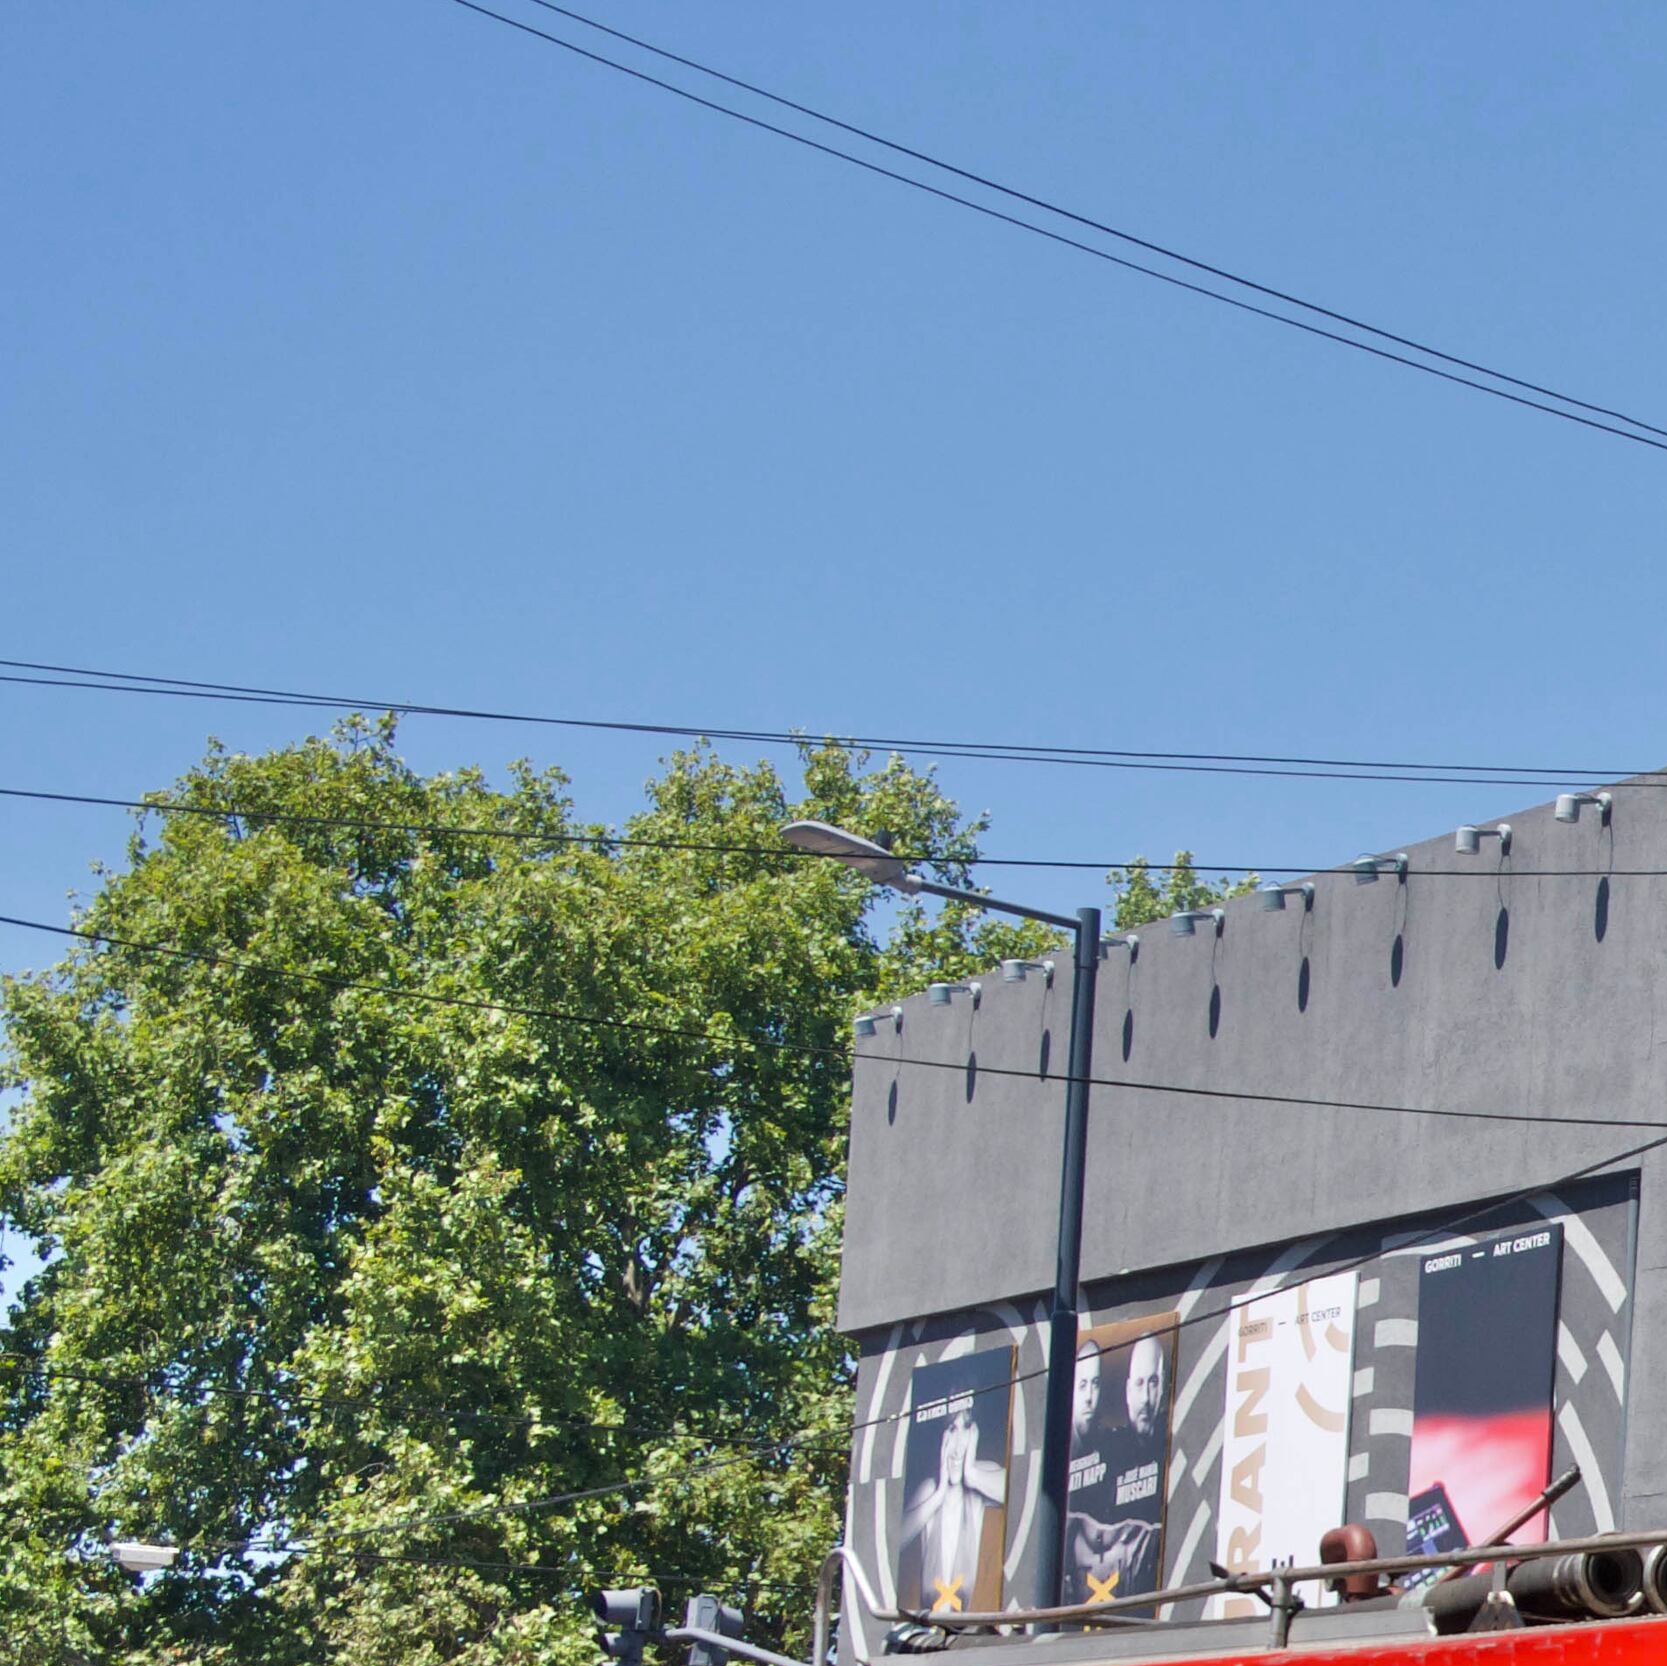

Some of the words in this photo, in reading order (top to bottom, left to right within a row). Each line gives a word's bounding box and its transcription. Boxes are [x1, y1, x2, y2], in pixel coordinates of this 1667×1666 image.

[1424, 1253, 1462, 1274] GORRITI
[1493, 1241, 1512, 1257] ART
[1513, 1232, 1550, 1252] CENTER
